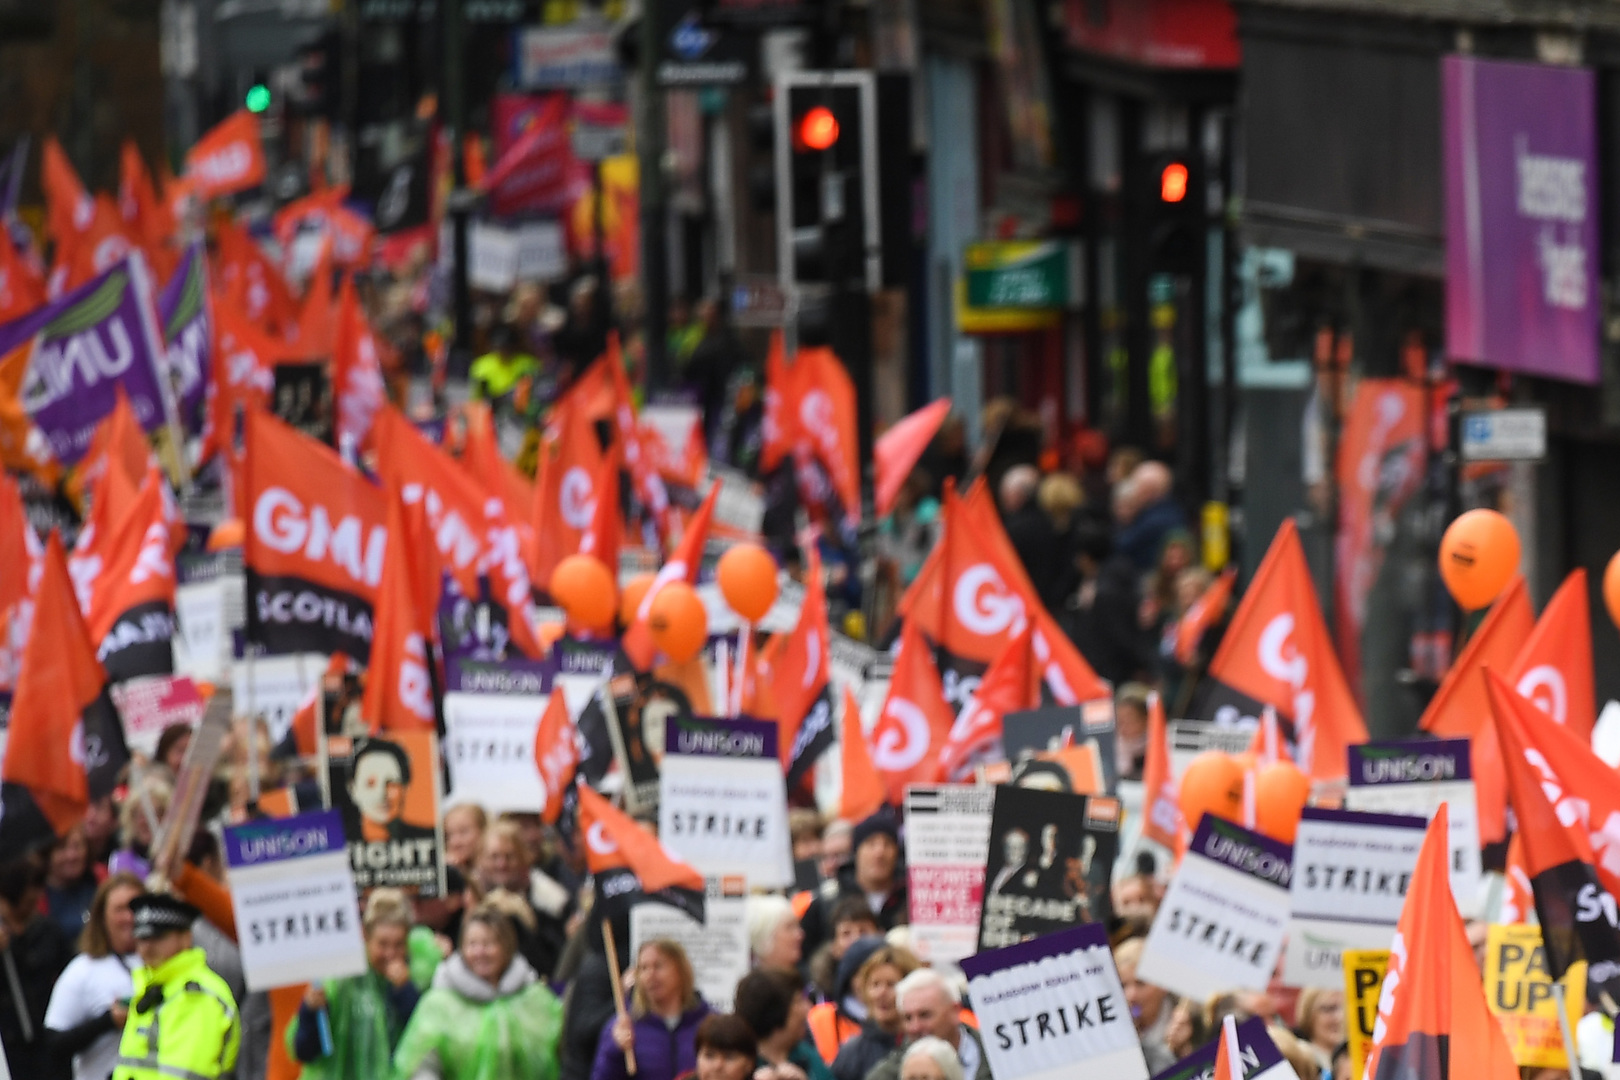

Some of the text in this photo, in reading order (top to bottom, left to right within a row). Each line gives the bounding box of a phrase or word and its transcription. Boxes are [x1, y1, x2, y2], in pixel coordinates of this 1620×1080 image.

[257, 590, 374, 641] SCOTLA
[1363, 755, 1456, 785] UNISON
[673, 812, 767, 840] STRIKE
[240, 827, 329, 862] UNISON
[352, 841, 434, 870] IGHT
[250, 912, 347, 945] STRIKE
[1170, 909, 1269, 967] STRIKE
[995, 994, 1117, 1050] STRIKE
